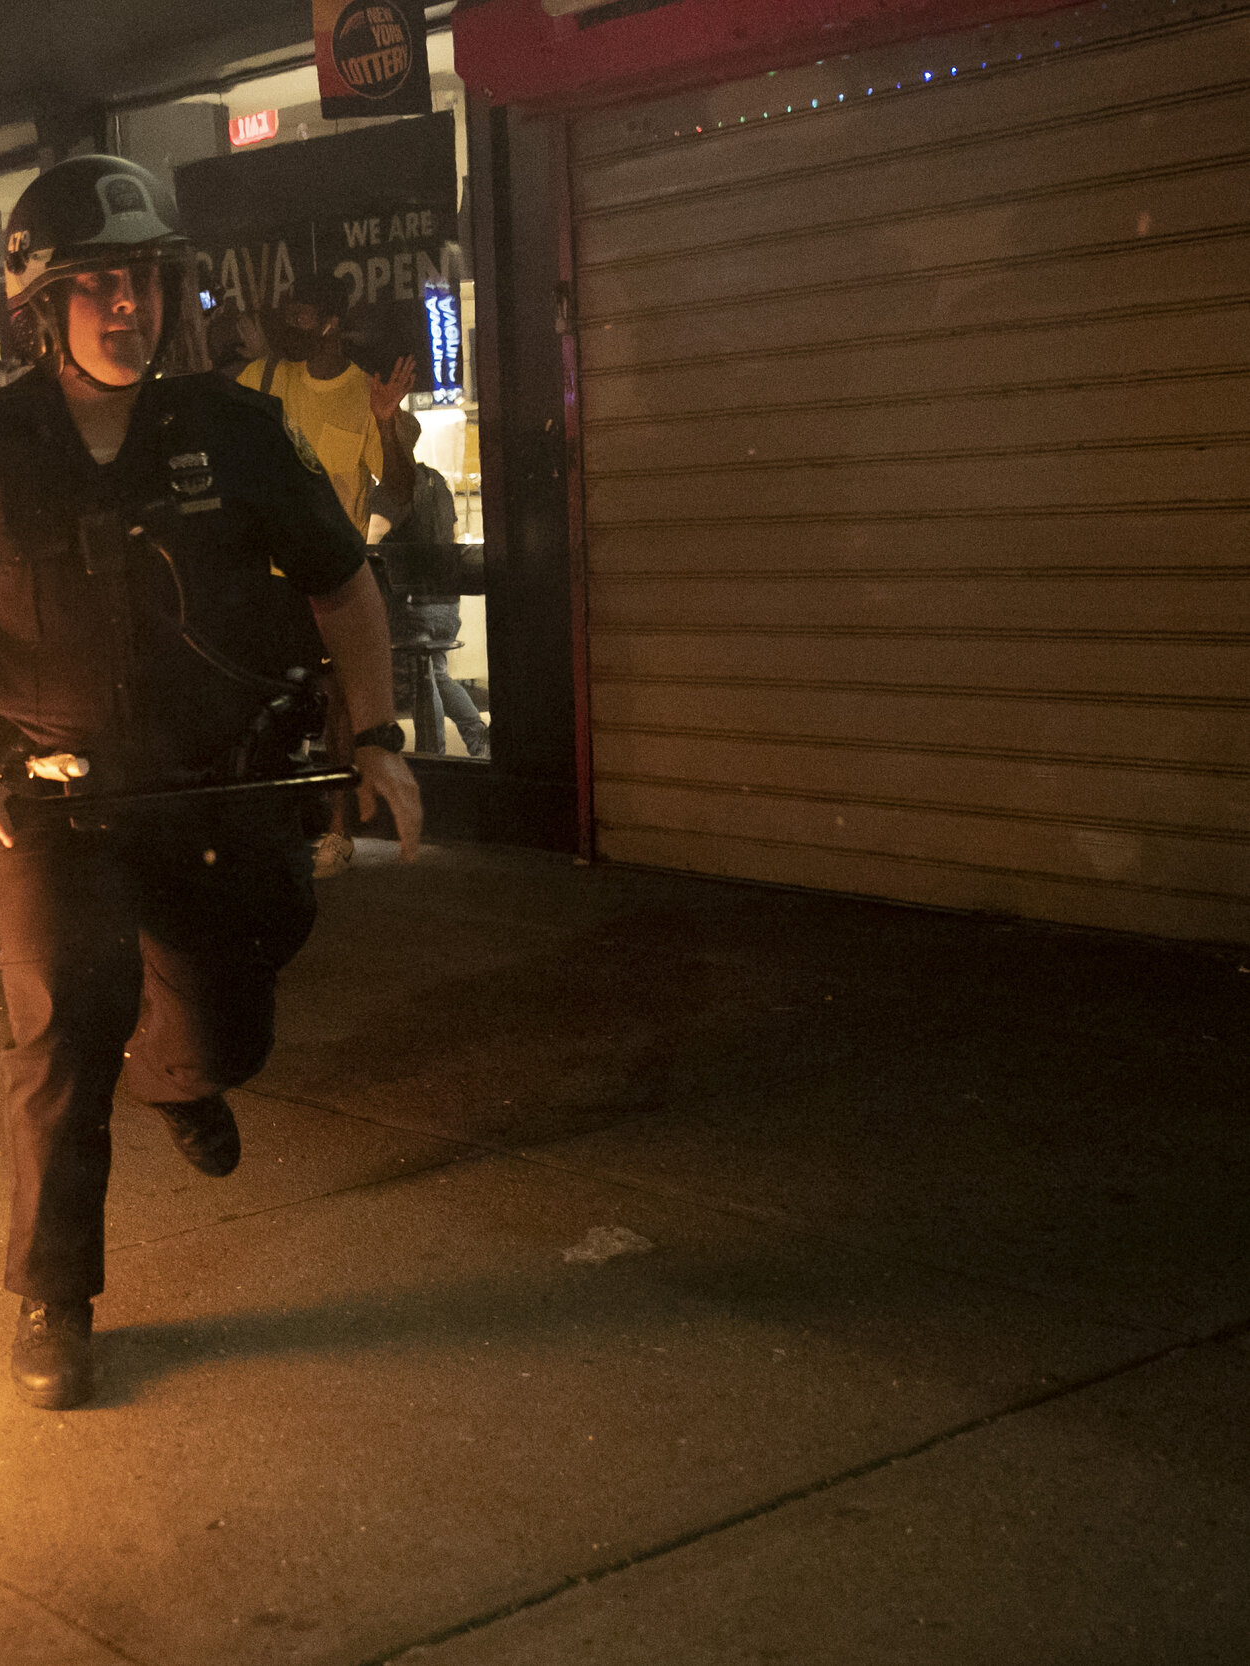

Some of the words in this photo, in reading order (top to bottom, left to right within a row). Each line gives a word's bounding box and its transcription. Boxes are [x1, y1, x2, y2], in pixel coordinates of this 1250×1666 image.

[341, 44, 408, 85] LOTTERY
[343, 217, 381, 248] WE
[388, 210, 434, 242] ARE
